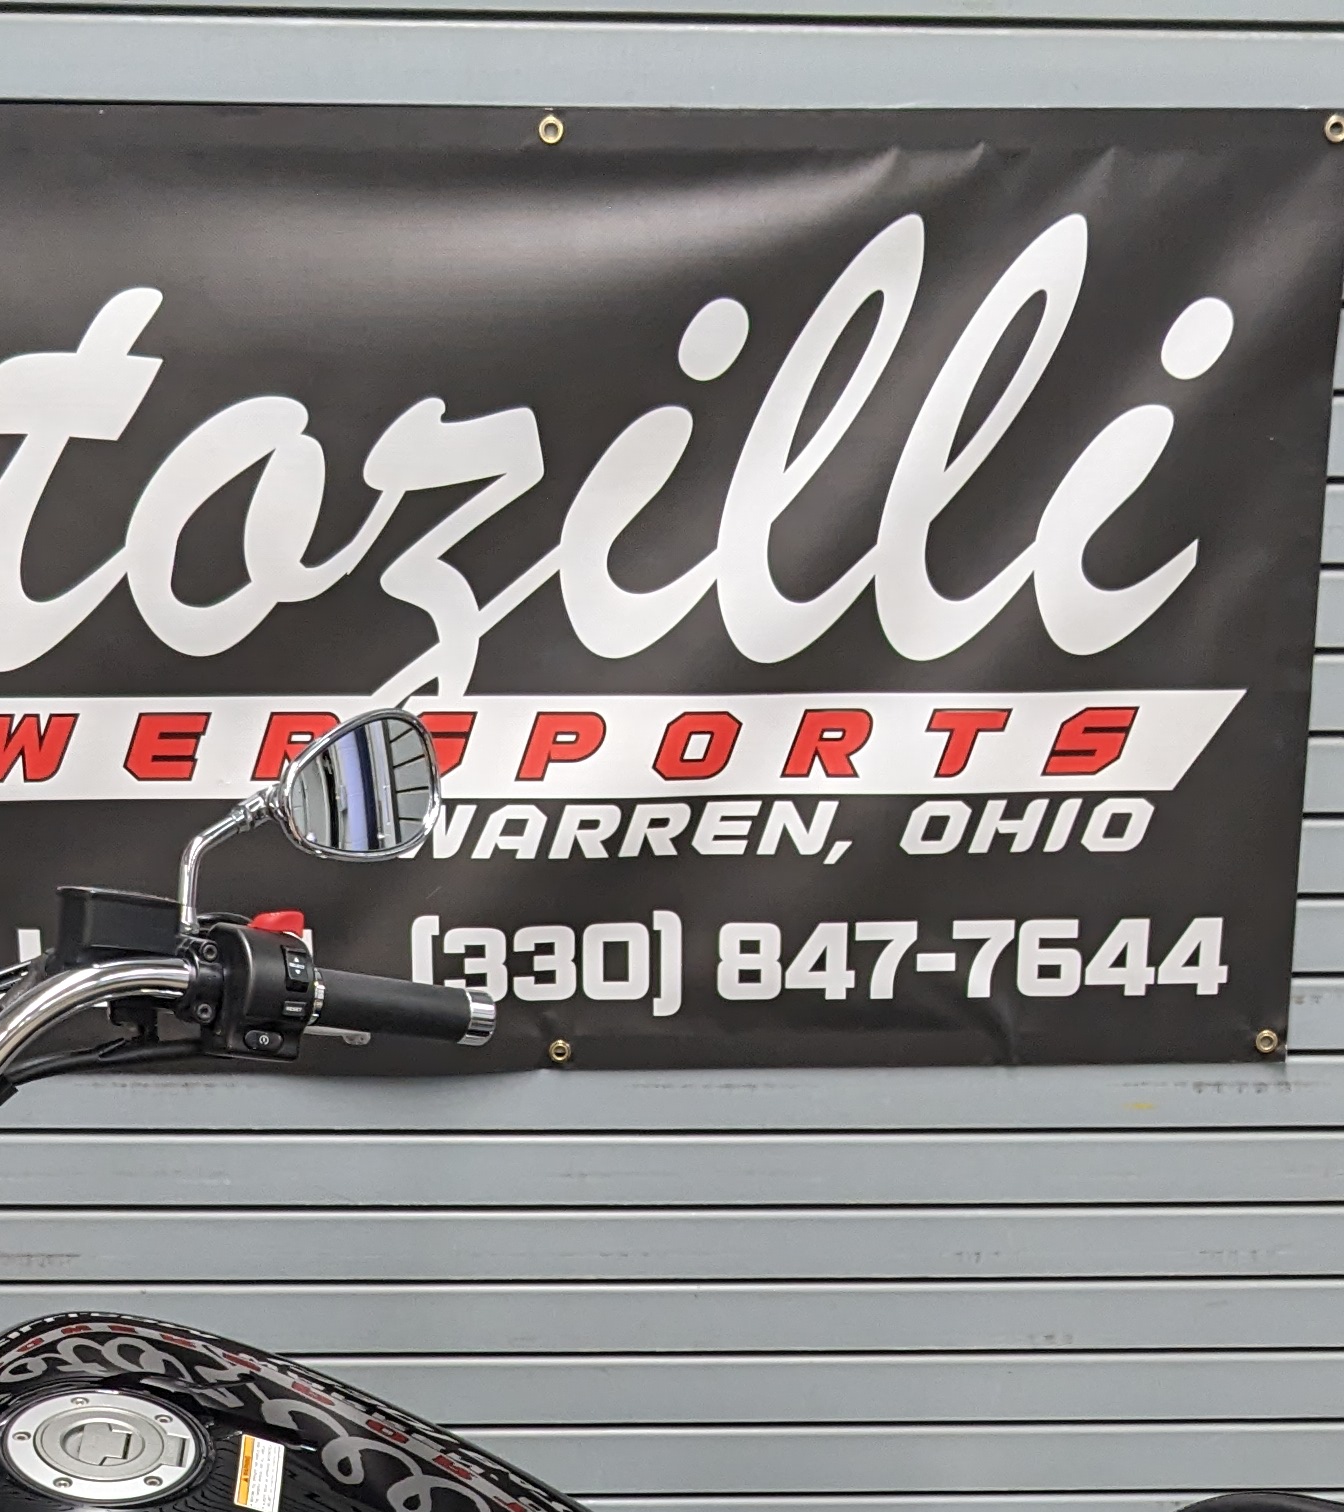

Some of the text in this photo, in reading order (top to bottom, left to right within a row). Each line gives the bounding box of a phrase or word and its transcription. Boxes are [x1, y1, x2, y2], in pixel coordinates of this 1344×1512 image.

[899, 798, 1155, 854] OHIO
[410, 910, 683, 1017] (330)
[716, 917, 1228, 1001] 847-7644
